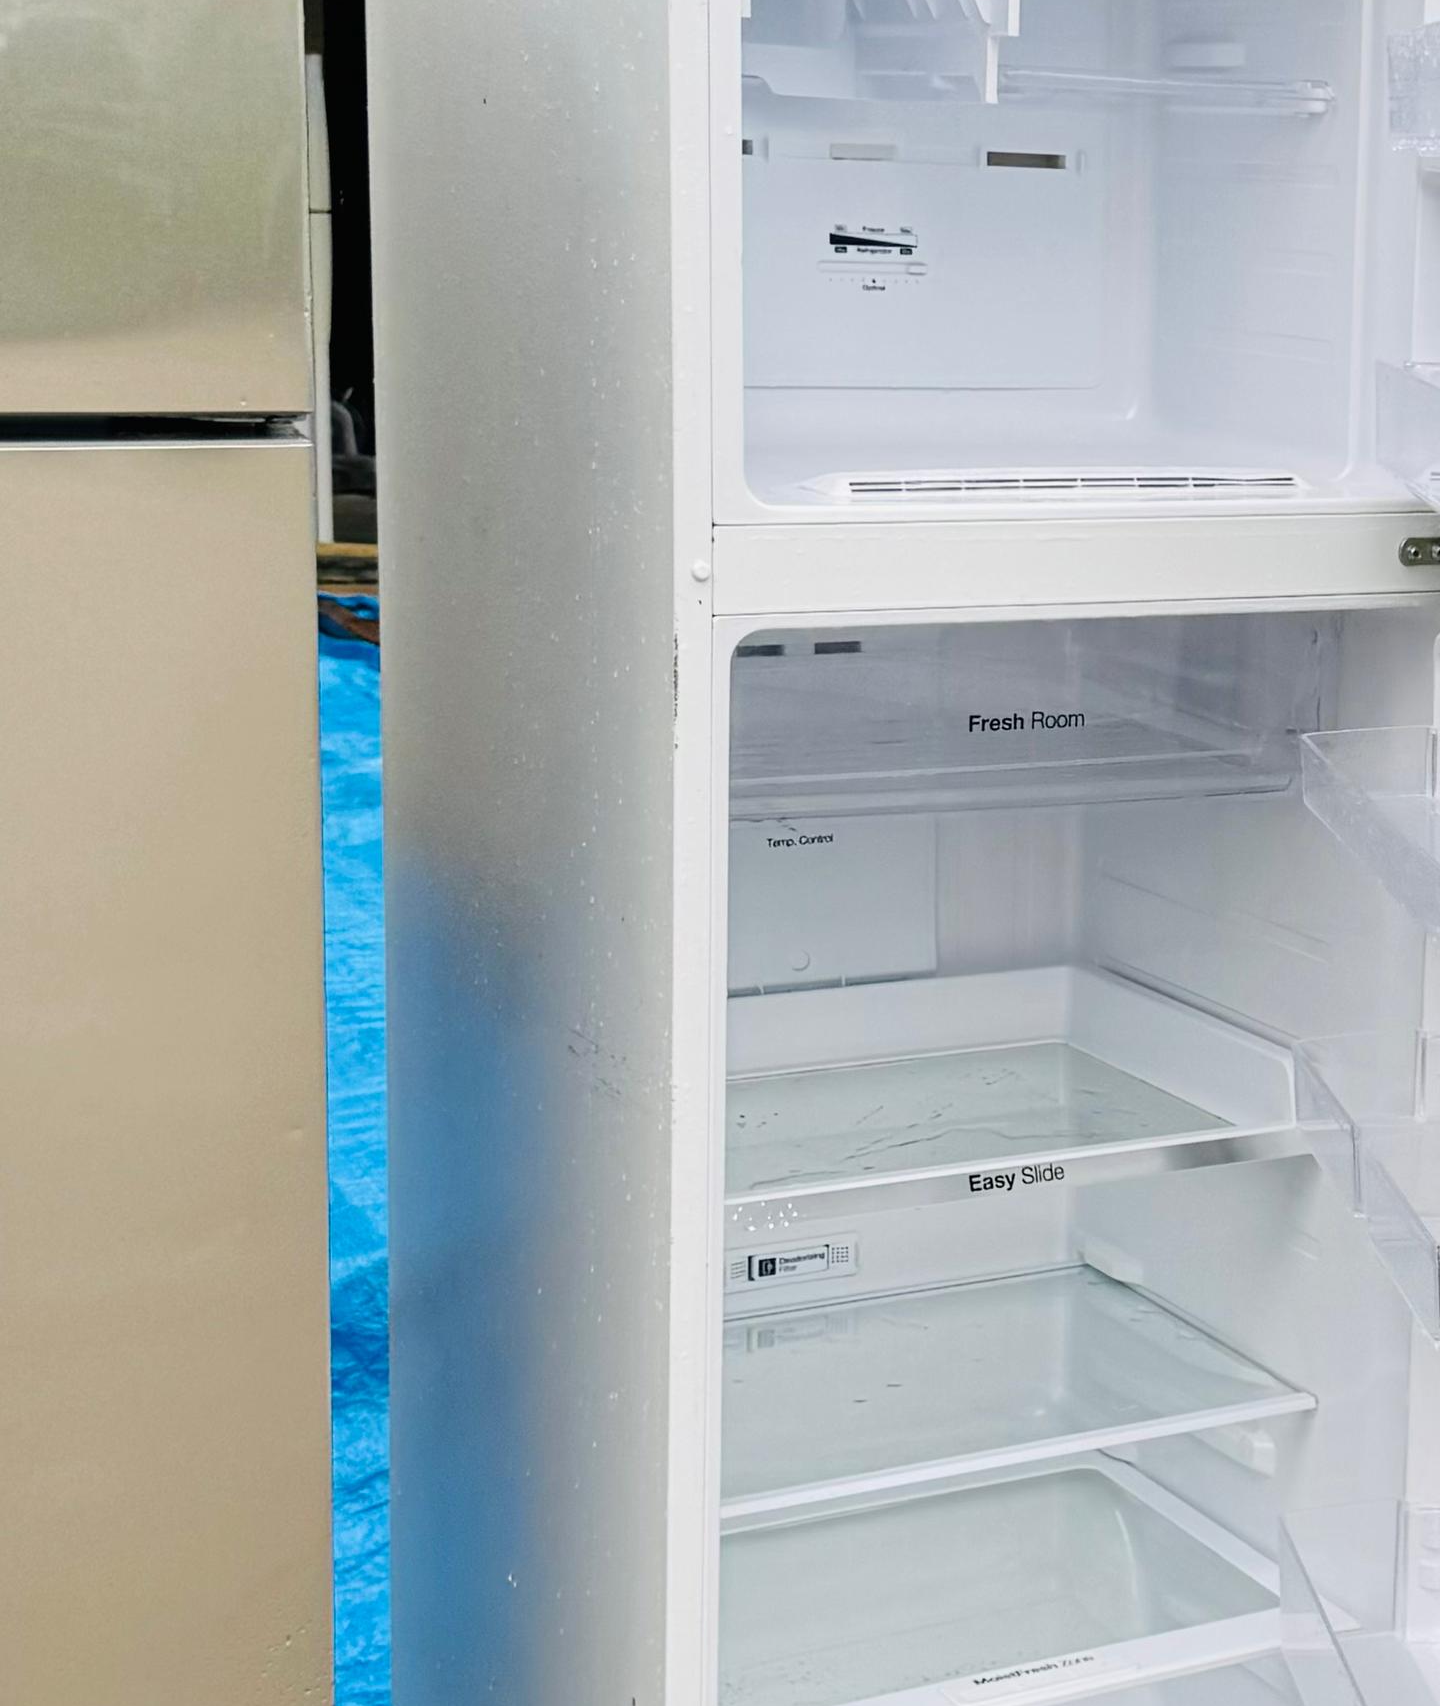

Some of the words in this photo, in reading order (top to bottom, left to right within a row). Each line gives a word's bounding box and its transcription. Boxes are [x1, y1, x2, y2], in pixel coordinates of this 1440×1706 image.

[968, 712, 1025, 733] Fresh
[1031, 711, 1086, 730] Room
[766, 837, 798, 848] Temp.
[799, 832, 834, 846] Control
[968, 1173, 1016, 1192] Easy
[1021, 1162, 1065, 1185] Slide
